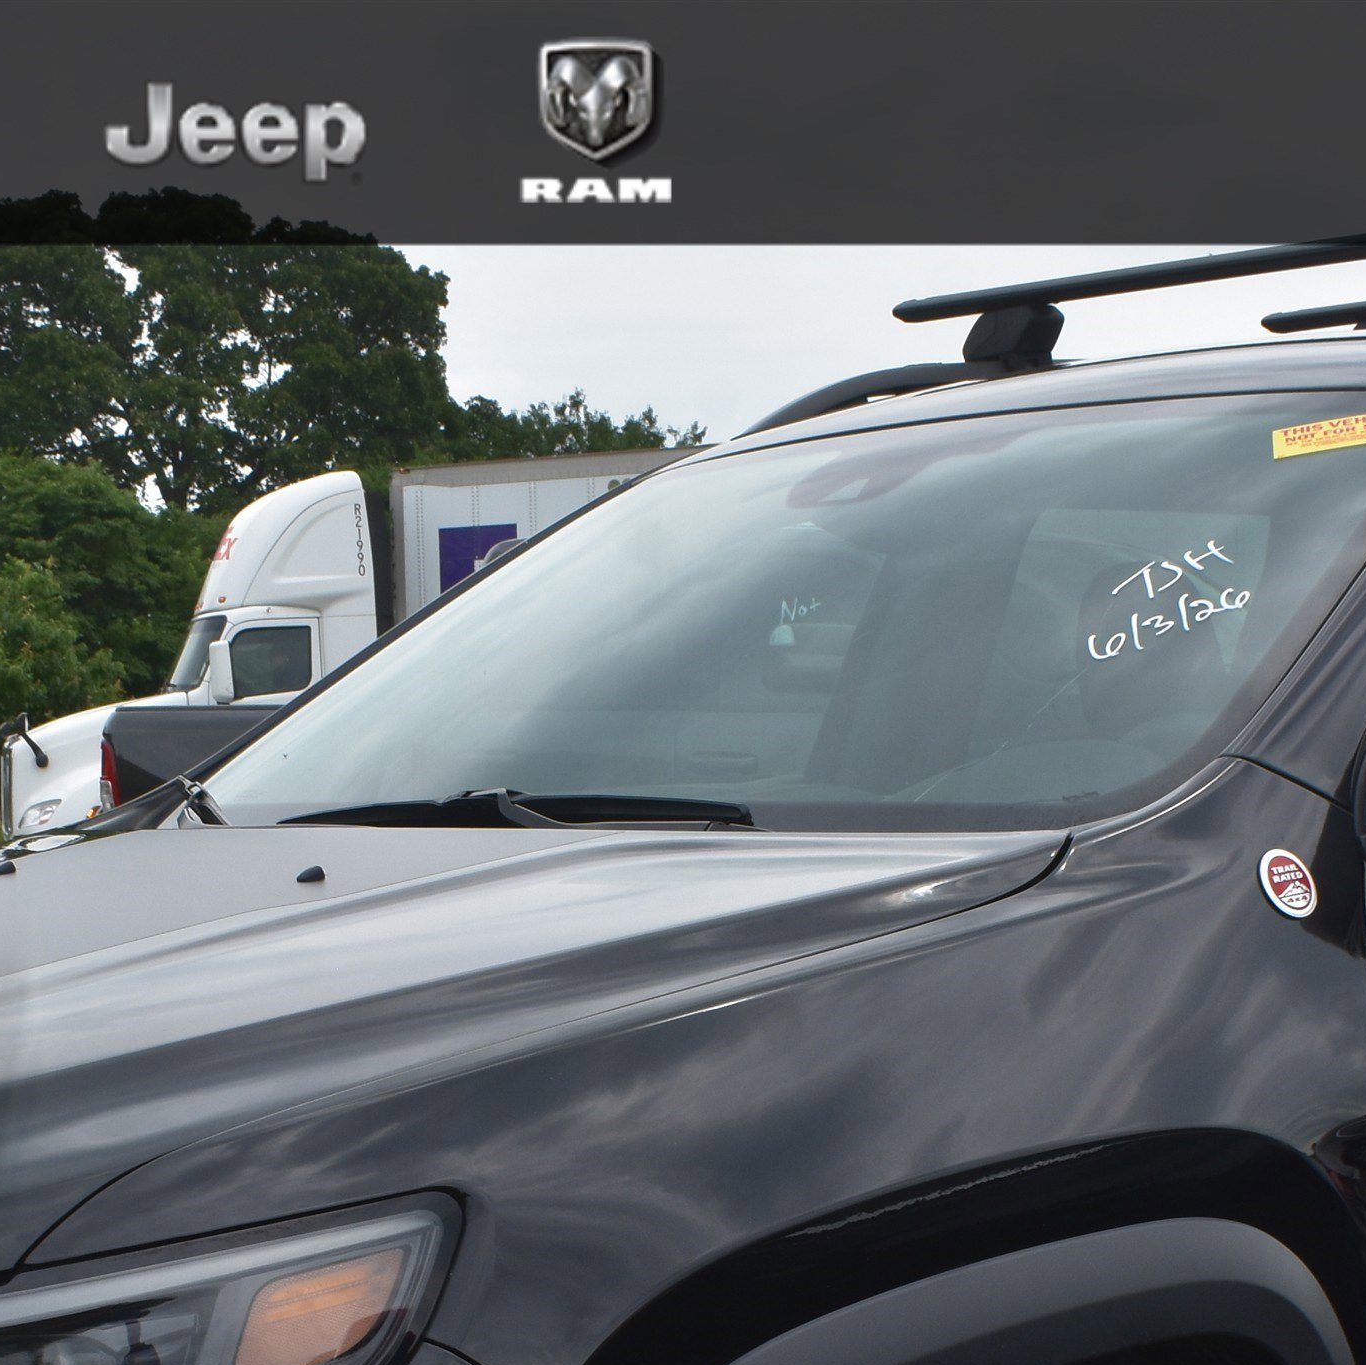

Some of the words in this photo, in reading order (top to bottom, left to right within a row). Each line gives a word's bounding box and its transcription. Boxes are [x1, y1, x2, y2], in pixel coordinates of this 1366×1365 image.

[1282, 423, 1323, 437] THIS
[1285, 432, 1315, 443] NOT
[1323, 426, 1356, 436] FOR
[354, 503, 366, 577] R21990
[780, 597, 821, 624] Not
[1087, 588, 1251, 660] 6/3/26
[1271, 864, 1299, 874] TRAIL
[1272, 871, 1303, 883] RATED
